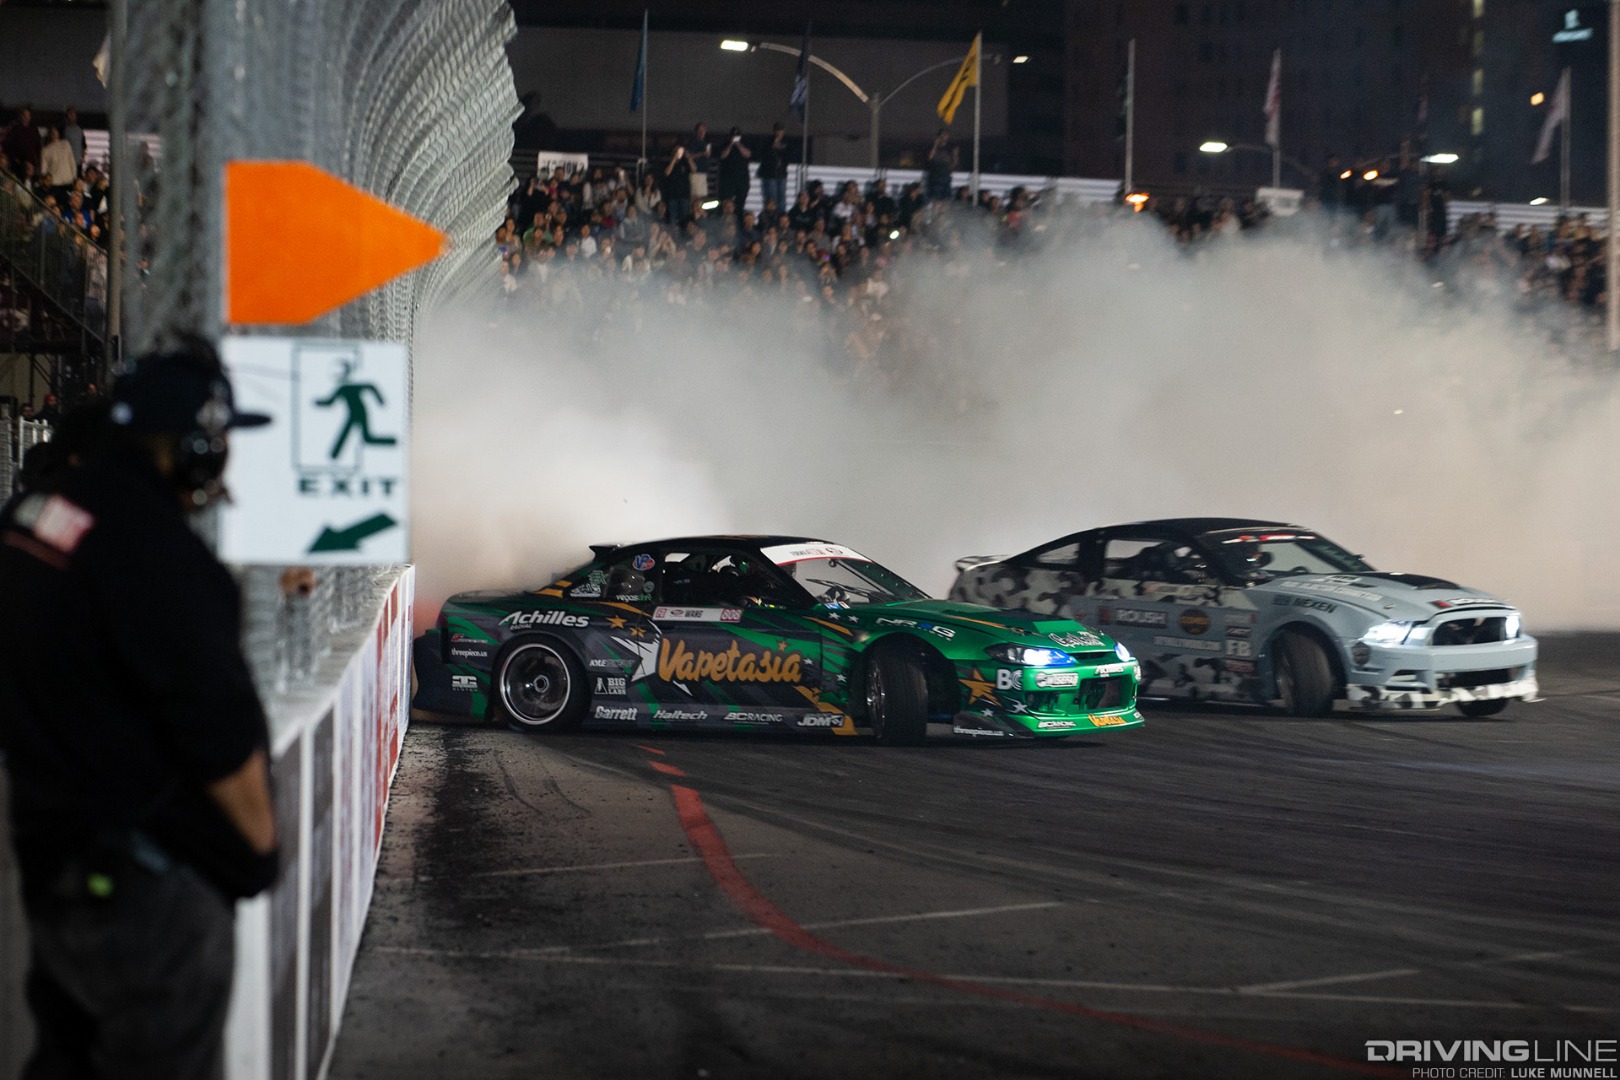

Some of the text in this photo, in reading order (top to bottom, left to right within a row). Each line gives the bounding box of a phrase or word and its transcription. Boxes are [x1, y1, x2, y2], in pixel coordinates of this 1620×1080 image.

[298, 478, 398, 496] EXIT
[1291, 597, 1338, 614] NEXEN
[498, 610, 590, 628] Achilles
[658, 637, 802, 682] Vapetasia
[608, 677, 626, 687] BIG
[594, 705, 638, 721] Garrett
[652, 709, 709, 720] Haltech
